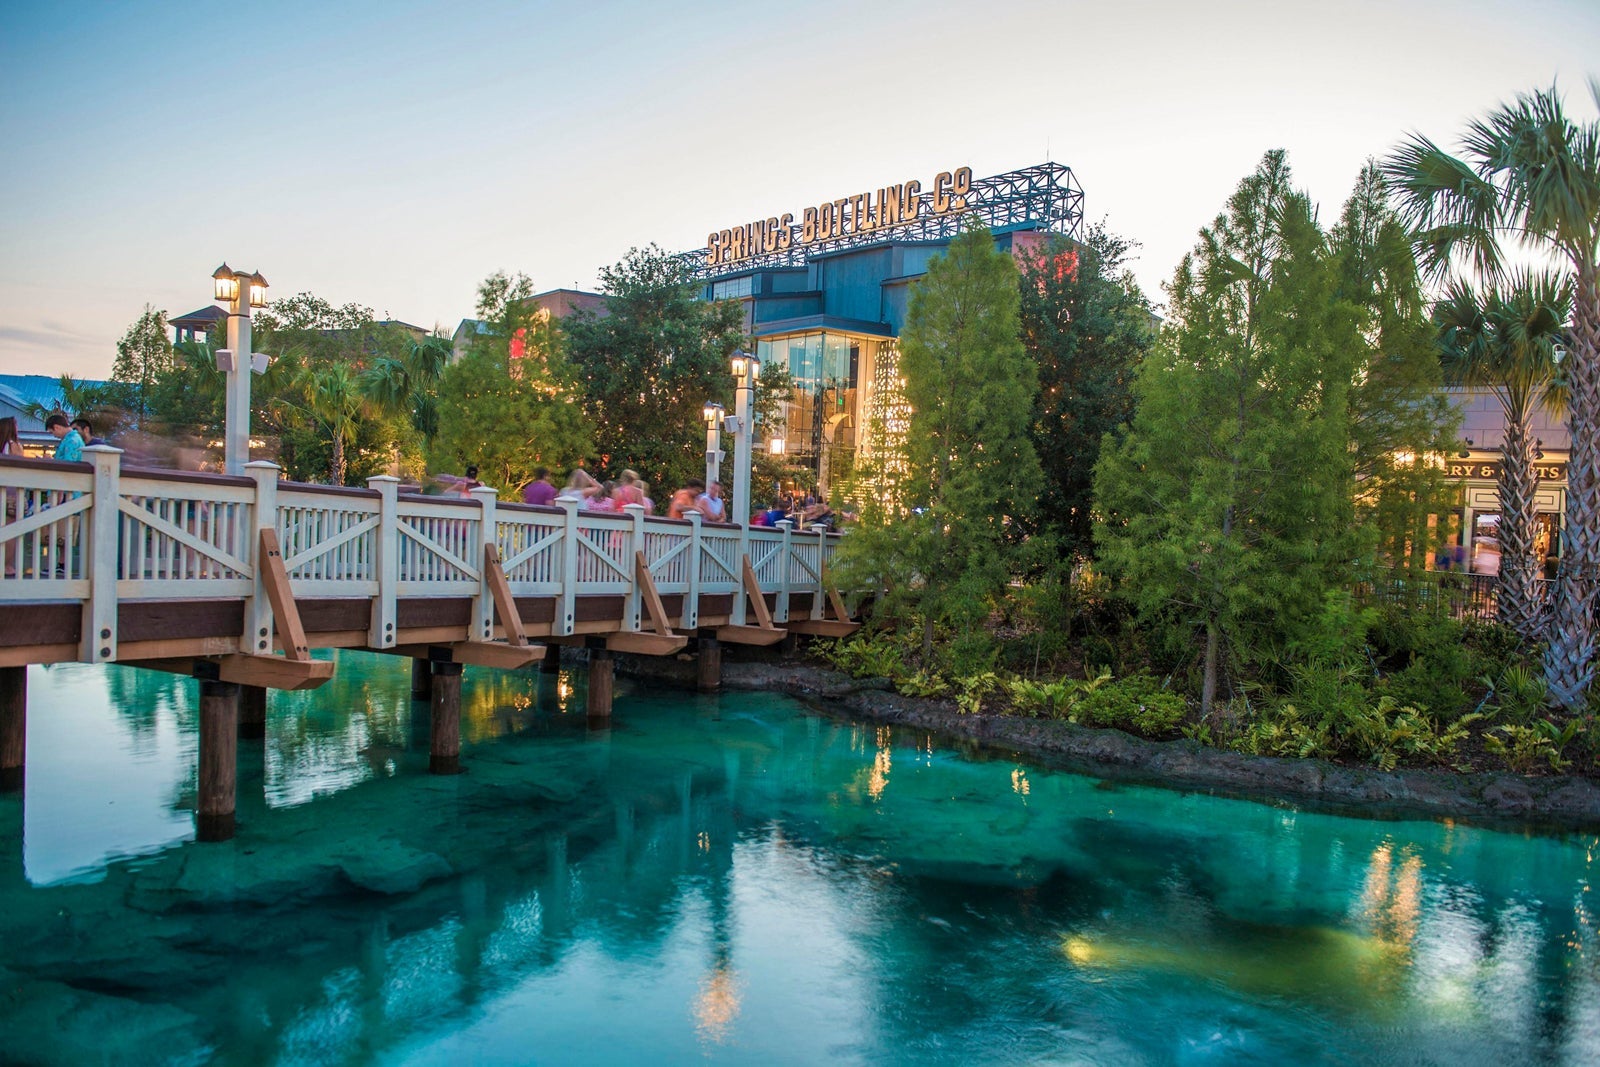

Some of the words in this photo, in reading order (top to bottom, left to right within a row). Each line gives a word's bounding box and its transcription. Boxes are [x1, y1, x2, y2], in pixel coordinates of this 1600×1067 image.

[707, 213, 793, 265] SPRINGS
[802, 180, 921, 243] BOTTLING
[1481, 465, 1494, 477] &
